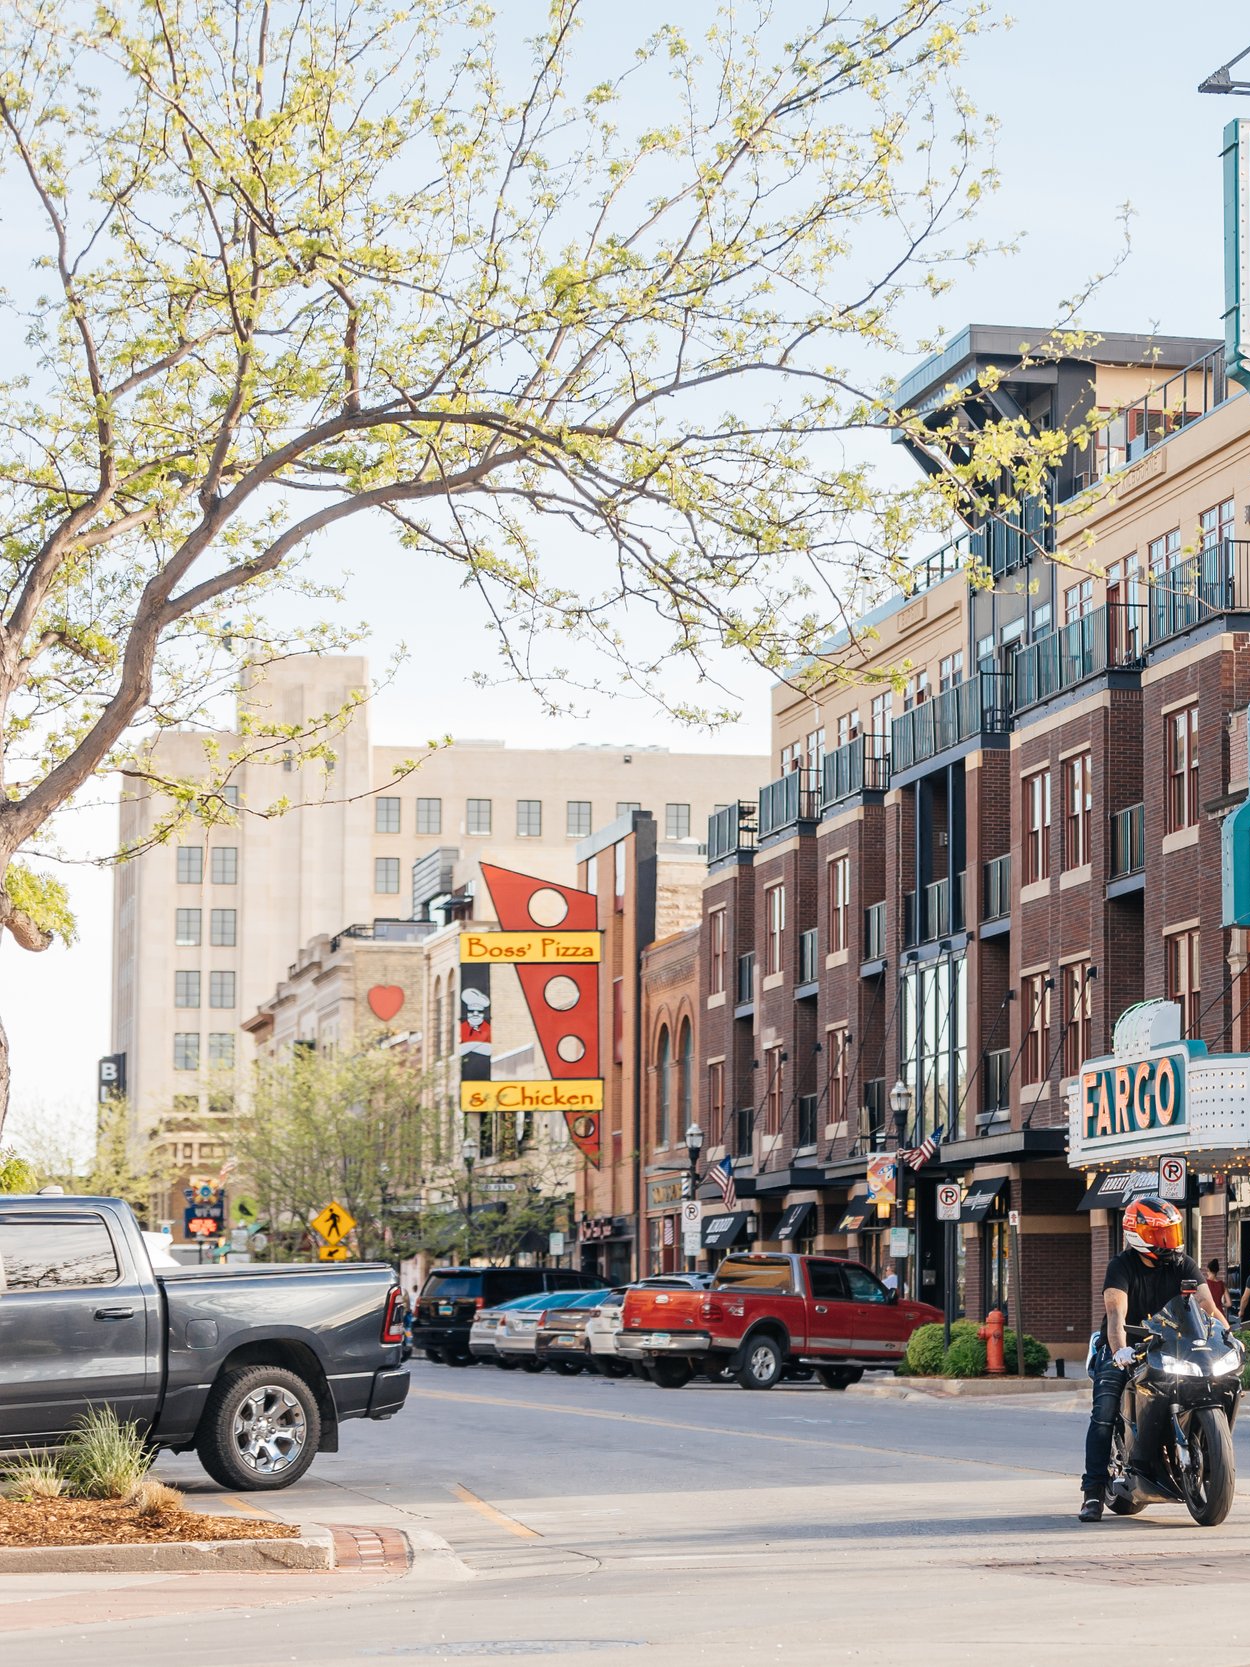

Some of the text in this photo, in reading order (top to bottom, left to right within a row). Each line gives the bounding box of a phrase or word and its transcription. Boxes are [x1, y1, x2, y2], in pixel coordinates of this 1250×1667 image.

[541, 938, 594, 958] Pizza
[469, 1085, 594, 1107] & Chicken
[1082, 1057, 1178, 1139] FARGO
